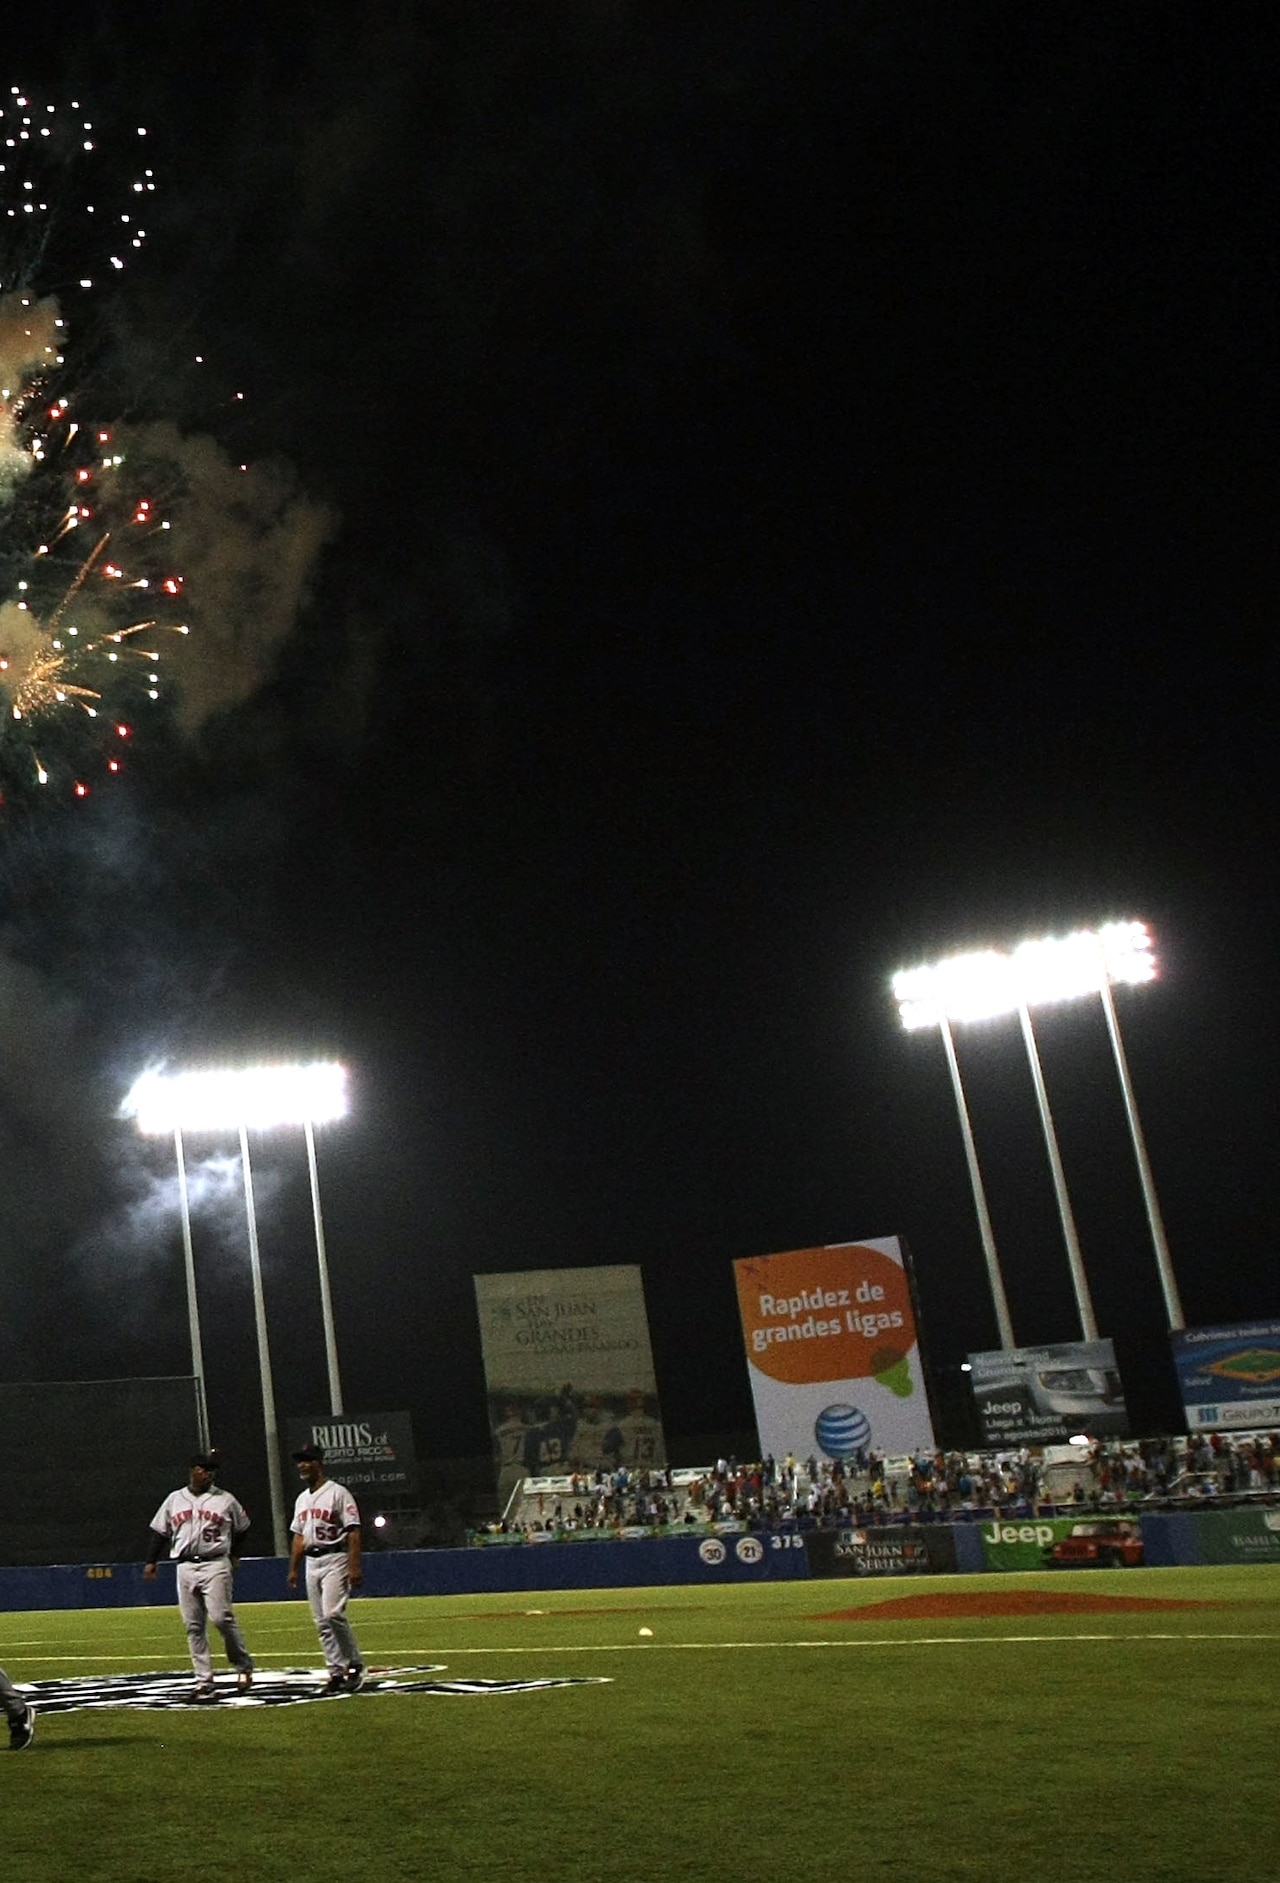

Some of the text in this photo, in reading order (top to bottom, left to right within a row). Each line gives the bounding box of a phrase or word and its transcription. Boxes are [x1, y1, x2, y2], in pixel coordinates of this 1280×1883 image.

[759, 1280, 885, 1320] Rapidez de
[515, 1302, 597, 1320] SAN JUAN
[515, 1328, 599, 1346] GRANDES
[751, 1310, 904, 1352] grandes ligas
[983, 1401, 1022, 1416] Jeep
[771, 1534, 804, 1549] 375
[986, 1523, 1054, 1547] Jeep
[704, 1548, 722, 1560] 30
[743, 1545, 756, 1558] 21
[835, 1543, 903, 1558] SAN JUAN
[857, 1556, 904, 1570] SERIES
